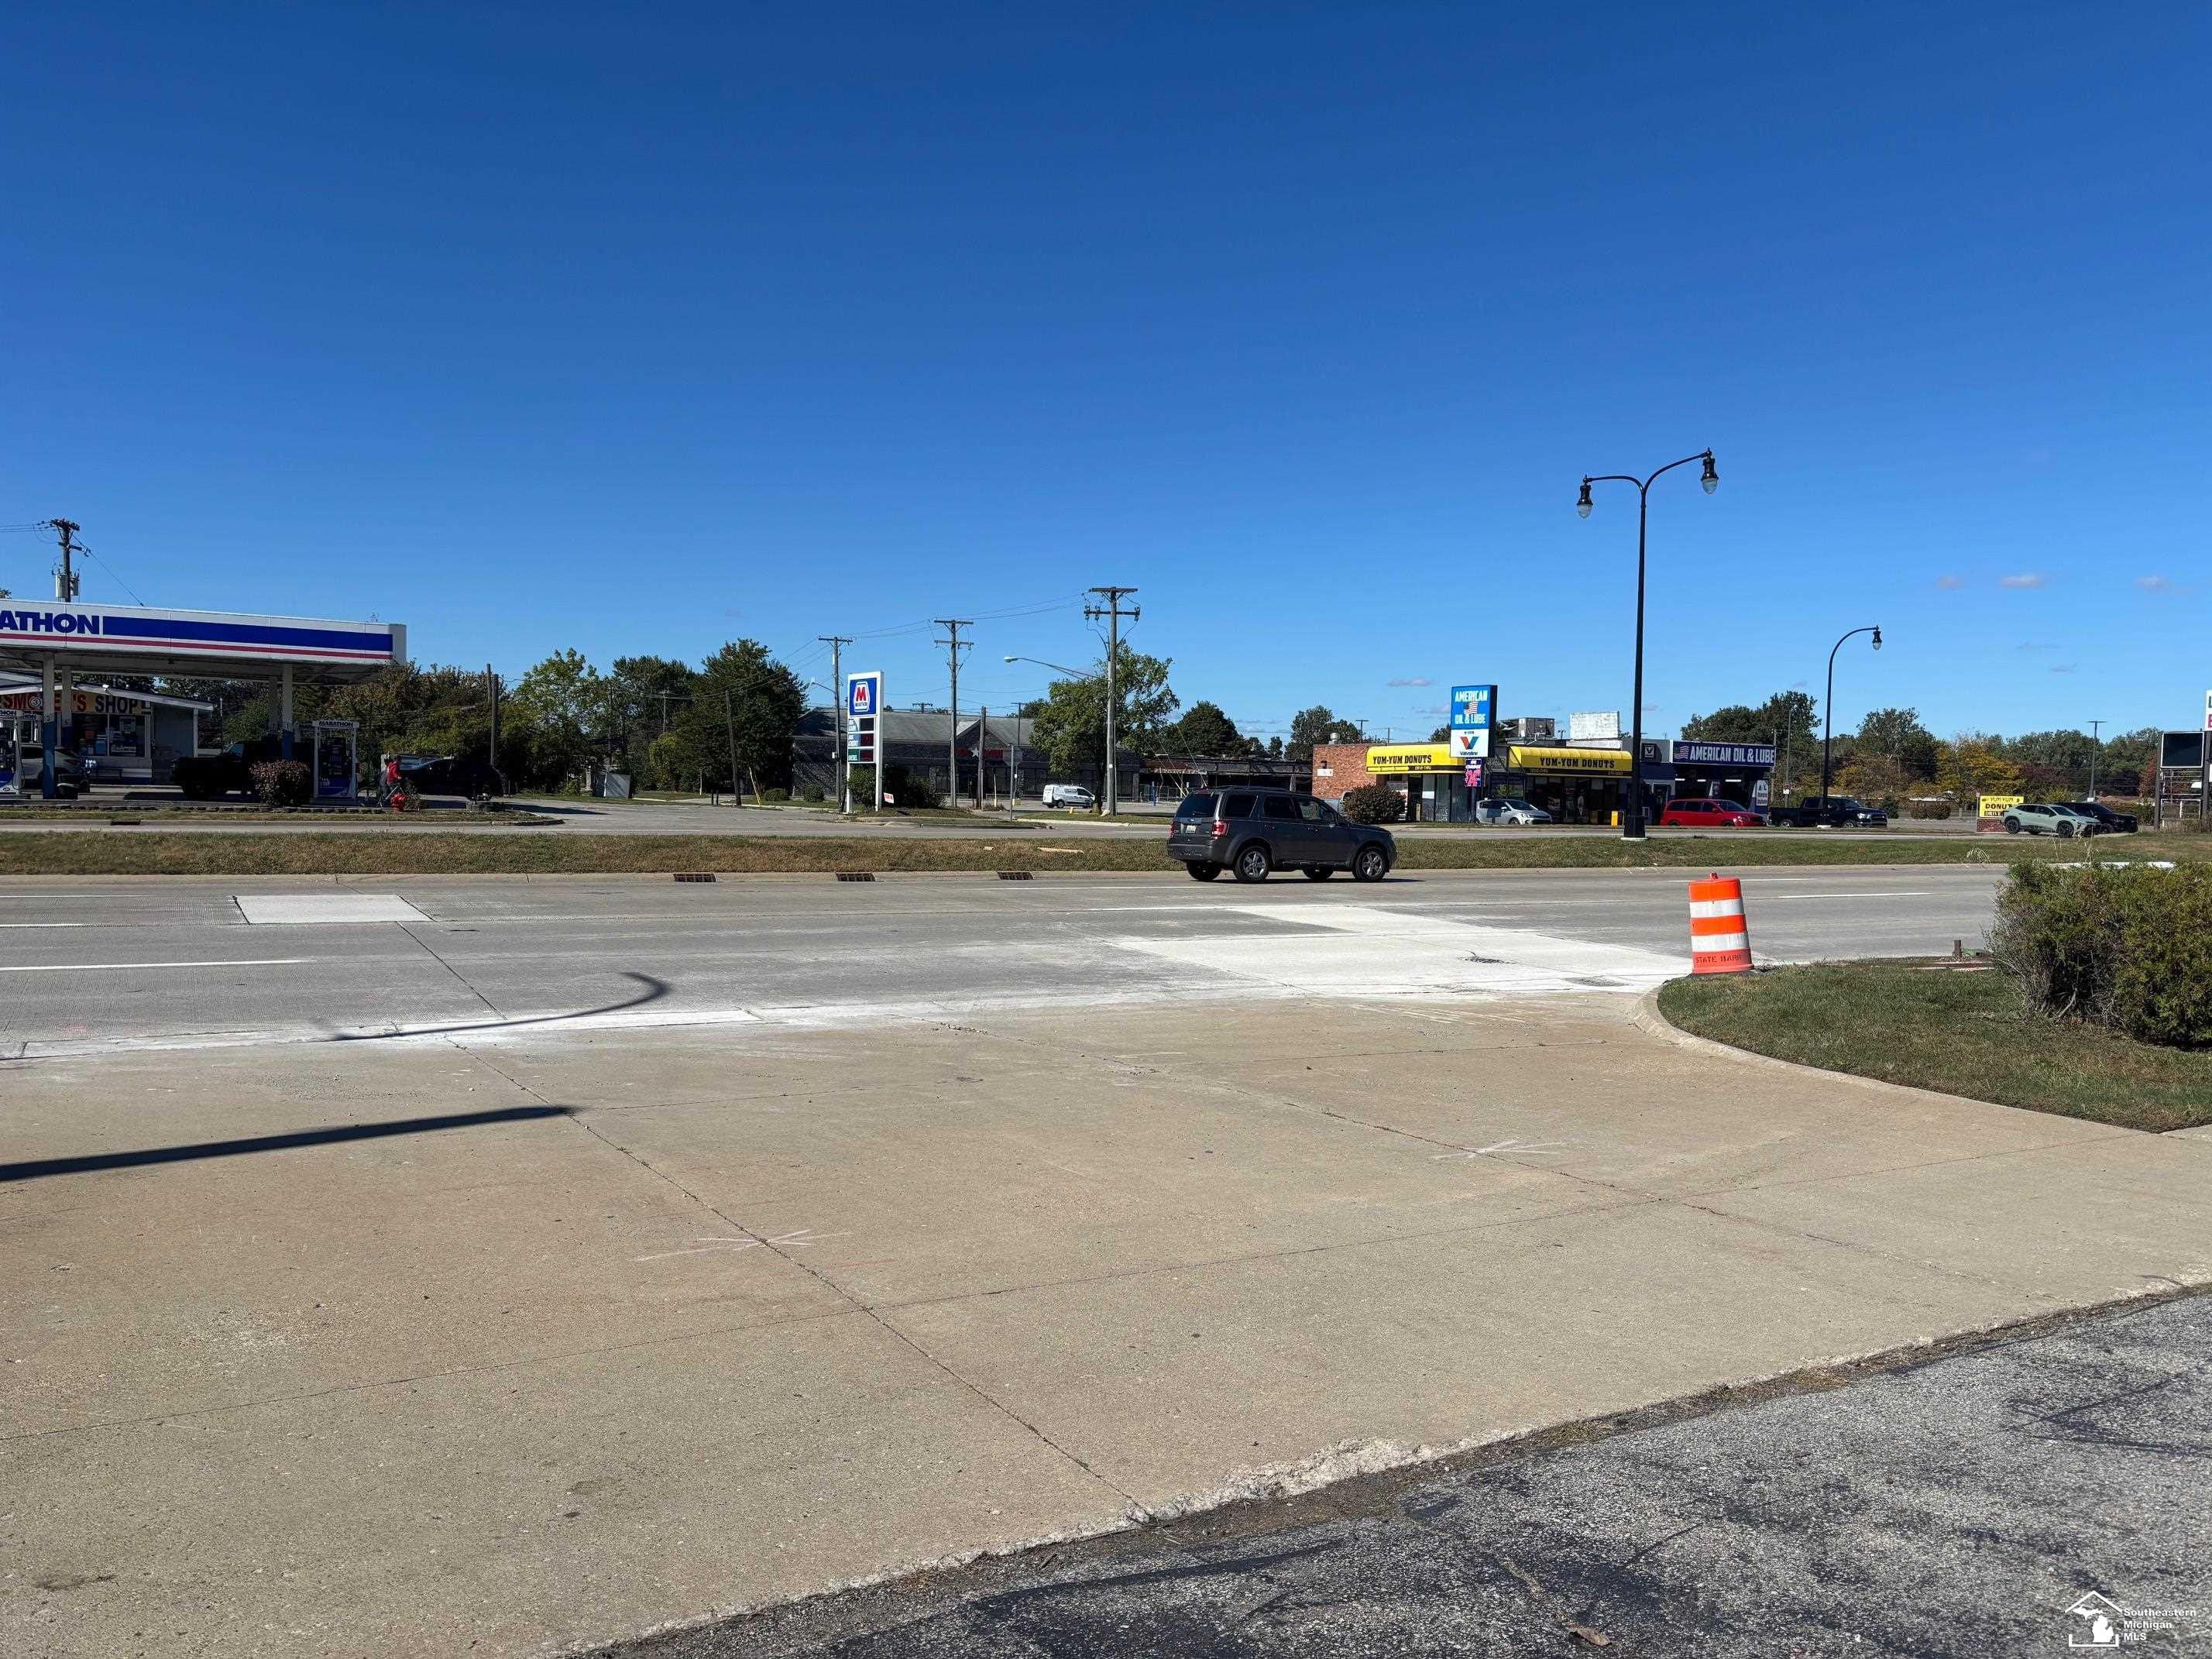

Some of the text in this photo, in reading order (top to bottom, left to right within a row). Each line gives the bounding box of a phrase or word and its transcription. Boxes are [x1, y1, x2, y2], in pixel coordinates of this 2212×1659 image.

[0, 610, 100, 635] ATHON
[1455, 690, 1488, 702] AMERICAN
[95, 695, 137, 713] SHOP
[1471, 713, 1486, 724] LUBE
[1372, 754, 1432, 764] YUM-YUM DONUTS
[1690, 745, 1775, 764] AMERICAN OIL & LUBE
[1540, 757, 1615, 769] YUM-YUM DONUTS
[1695, 955, 1717, 963] STATE
